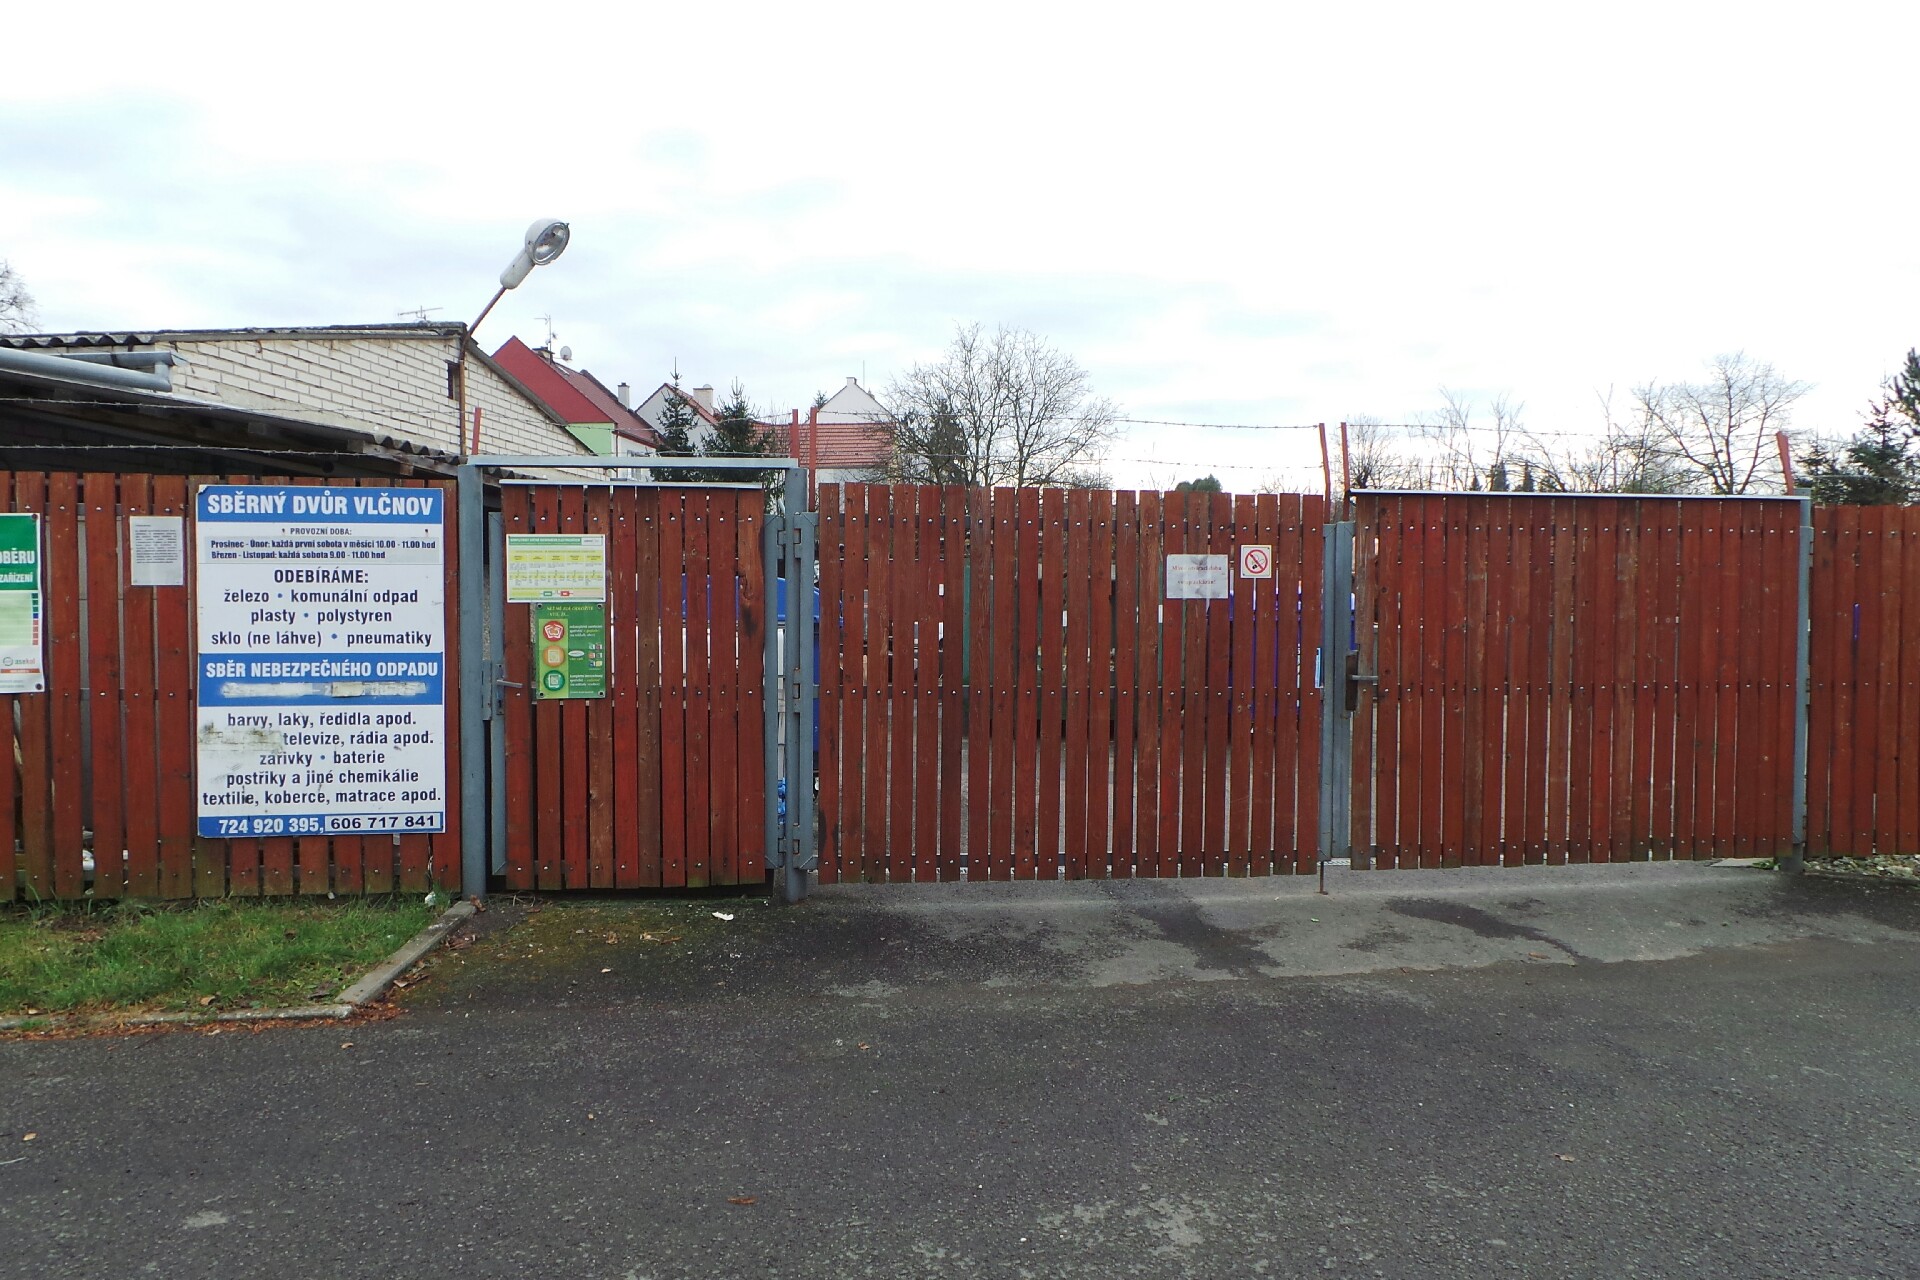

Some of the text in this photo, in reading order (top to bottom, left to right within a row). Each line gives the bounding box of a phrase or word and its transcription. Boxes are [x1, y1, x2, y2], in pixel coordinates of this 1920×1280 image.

[207, 490, 434, 516] SBĚRNÝ DVŮR VLČNOV
[290, 526, 328, 535] PROVOZNÍ
[211, 540, 244, 548] Prosinec
[250, 539, 270, 548] Únor:
[272, 540, 293, 548] každá
[295, 540, 315, 549] první
[317, 540, 342, 548] sobota
[349, 540, 374, 549] měsíci
[376, 540, 396, 549] 10.00
[402, 541, 420, 549] 11.00
[422, 541, 436, 549] hod
[211, 551, 237, 559] Březen
[243, 551, 277, 560] Listopad:
[278, 551, 300, 559] každá
[302, 551, 328, 559] sobota
[329, 551, 346, 559] 9.00
[352, 551, 369, 559] 11.00
[371, 551, 386, 559] hod
[274, 568, 369, 584] ODEBÍRÁME:
[224, 589, 418, 606] železo komunální odpad
[251, 608, 392, 625] plasty polystyren
[211, 630, 432, 648] sklo (ne láhve) pneumatiky
[206, 659, 438, 678] SBĚR NEBEZPEČNÉHO ODPADU
[227, 711, 417, 729] barvy, laky, ředidla apod.
[283, 731, 434, 748] televize, rádia apod.
[333, 750, 385, 765] baterie
[226, 769, 419, 788] postřiky a jiné chemikálie
[203, 787, 441, 807] textilie, koberce, matrace apod.
[219, 818, 325, 834] 724 920 395,
[330, 815, 435, 829] 606 717 841
